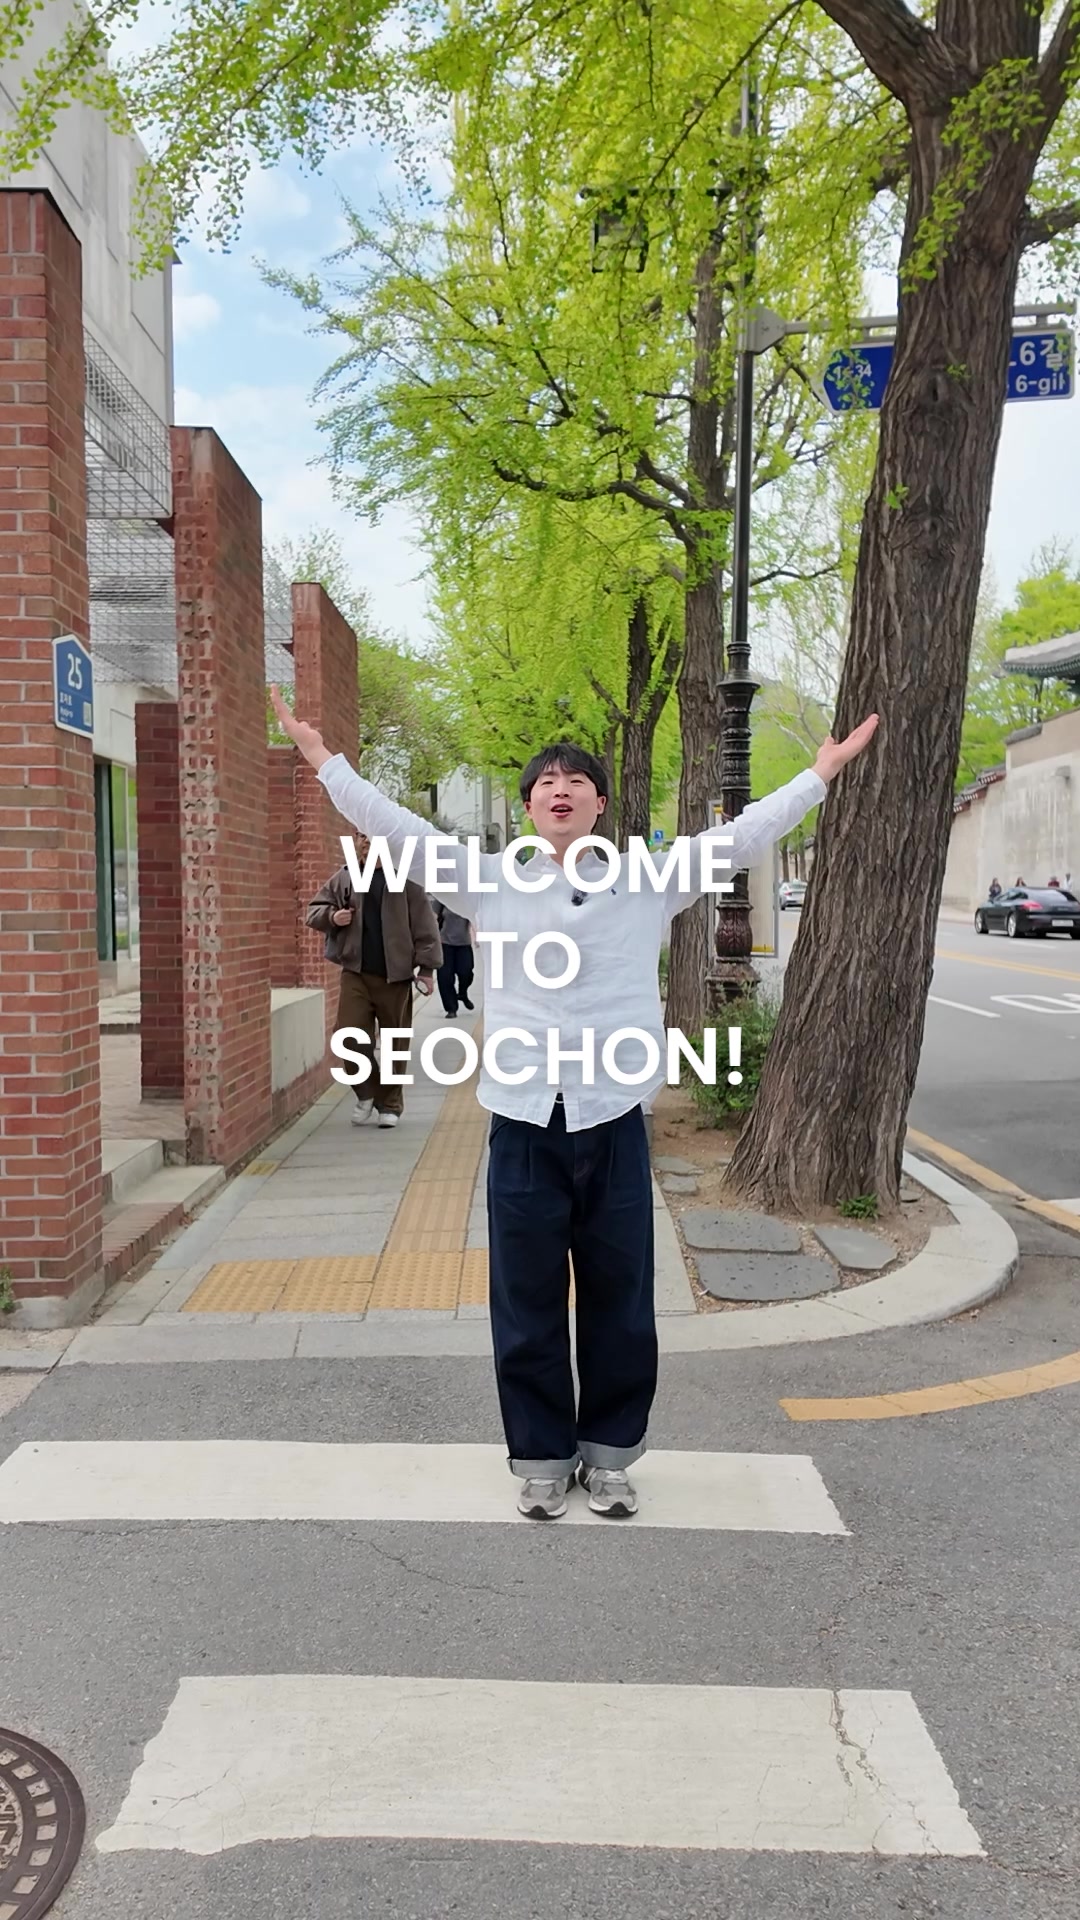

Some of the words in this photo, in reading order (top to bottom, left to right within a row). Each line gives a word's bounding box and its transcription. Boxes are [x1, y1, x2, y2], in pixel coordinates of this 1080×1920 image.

[1010, 339, 1063, 369] 6길
[1015, 373, 1064, 395] 6-gil
[67, 653, 83, 690] 25
